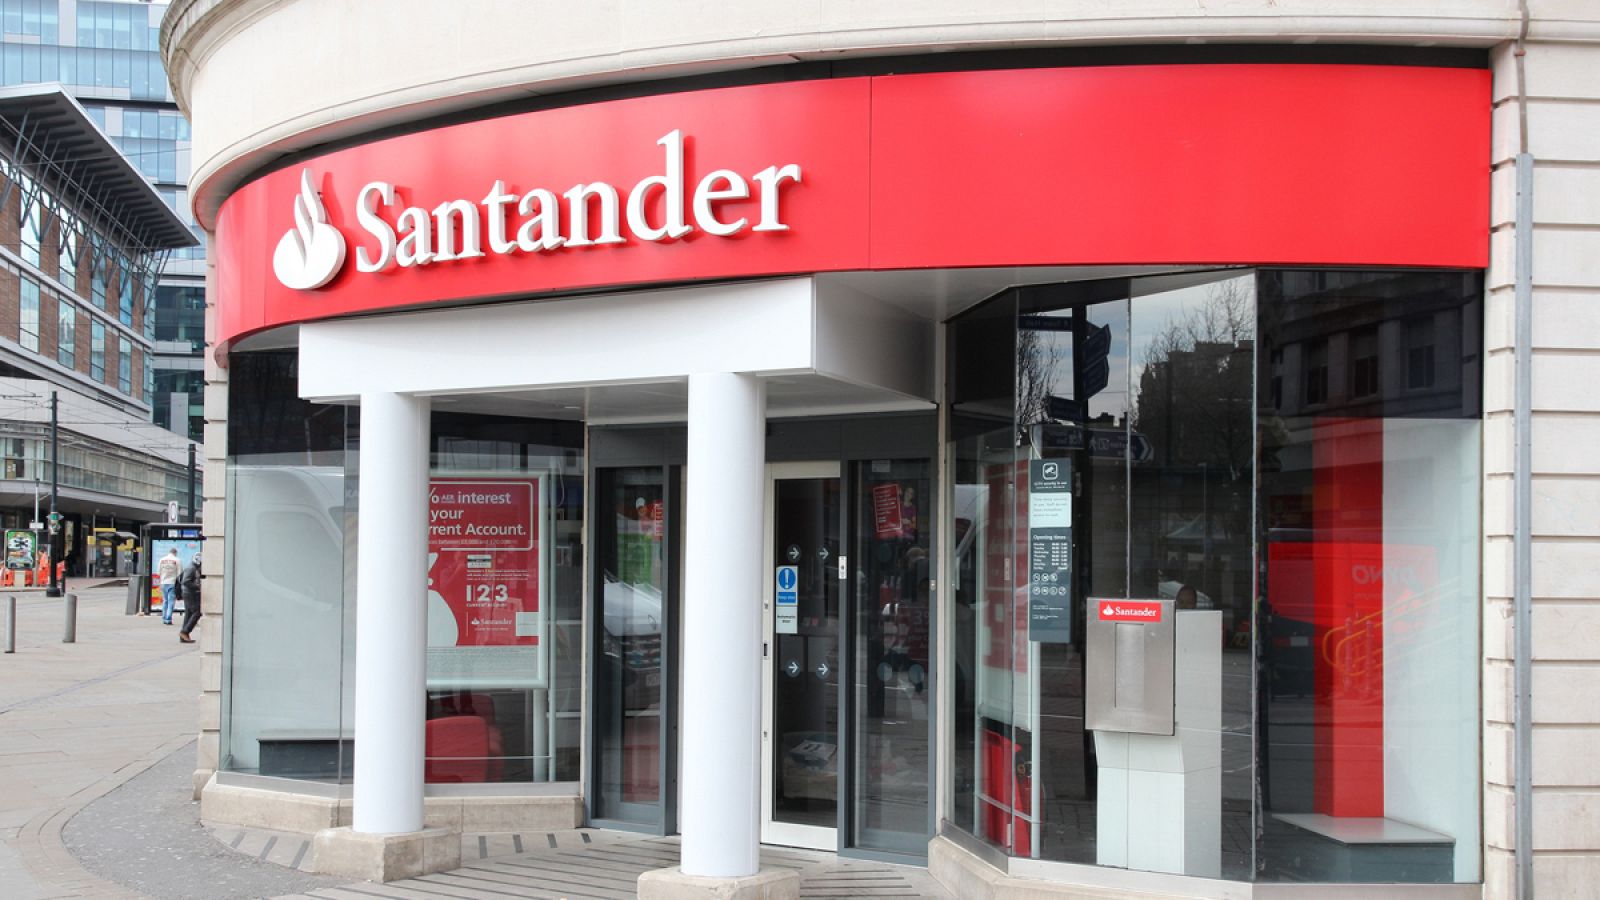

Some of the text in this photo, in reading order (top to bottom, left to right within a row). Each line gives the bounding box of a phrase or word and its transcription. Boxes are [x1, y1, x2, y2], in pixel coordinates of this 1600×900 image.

[355, 129, 802, 273] Santander
[457, 491, 512, 505] interest
[430, 509, 464, 522] your
[464, 523, 527, 536] Account.
[1115, 606, 1157, 617] Santander
